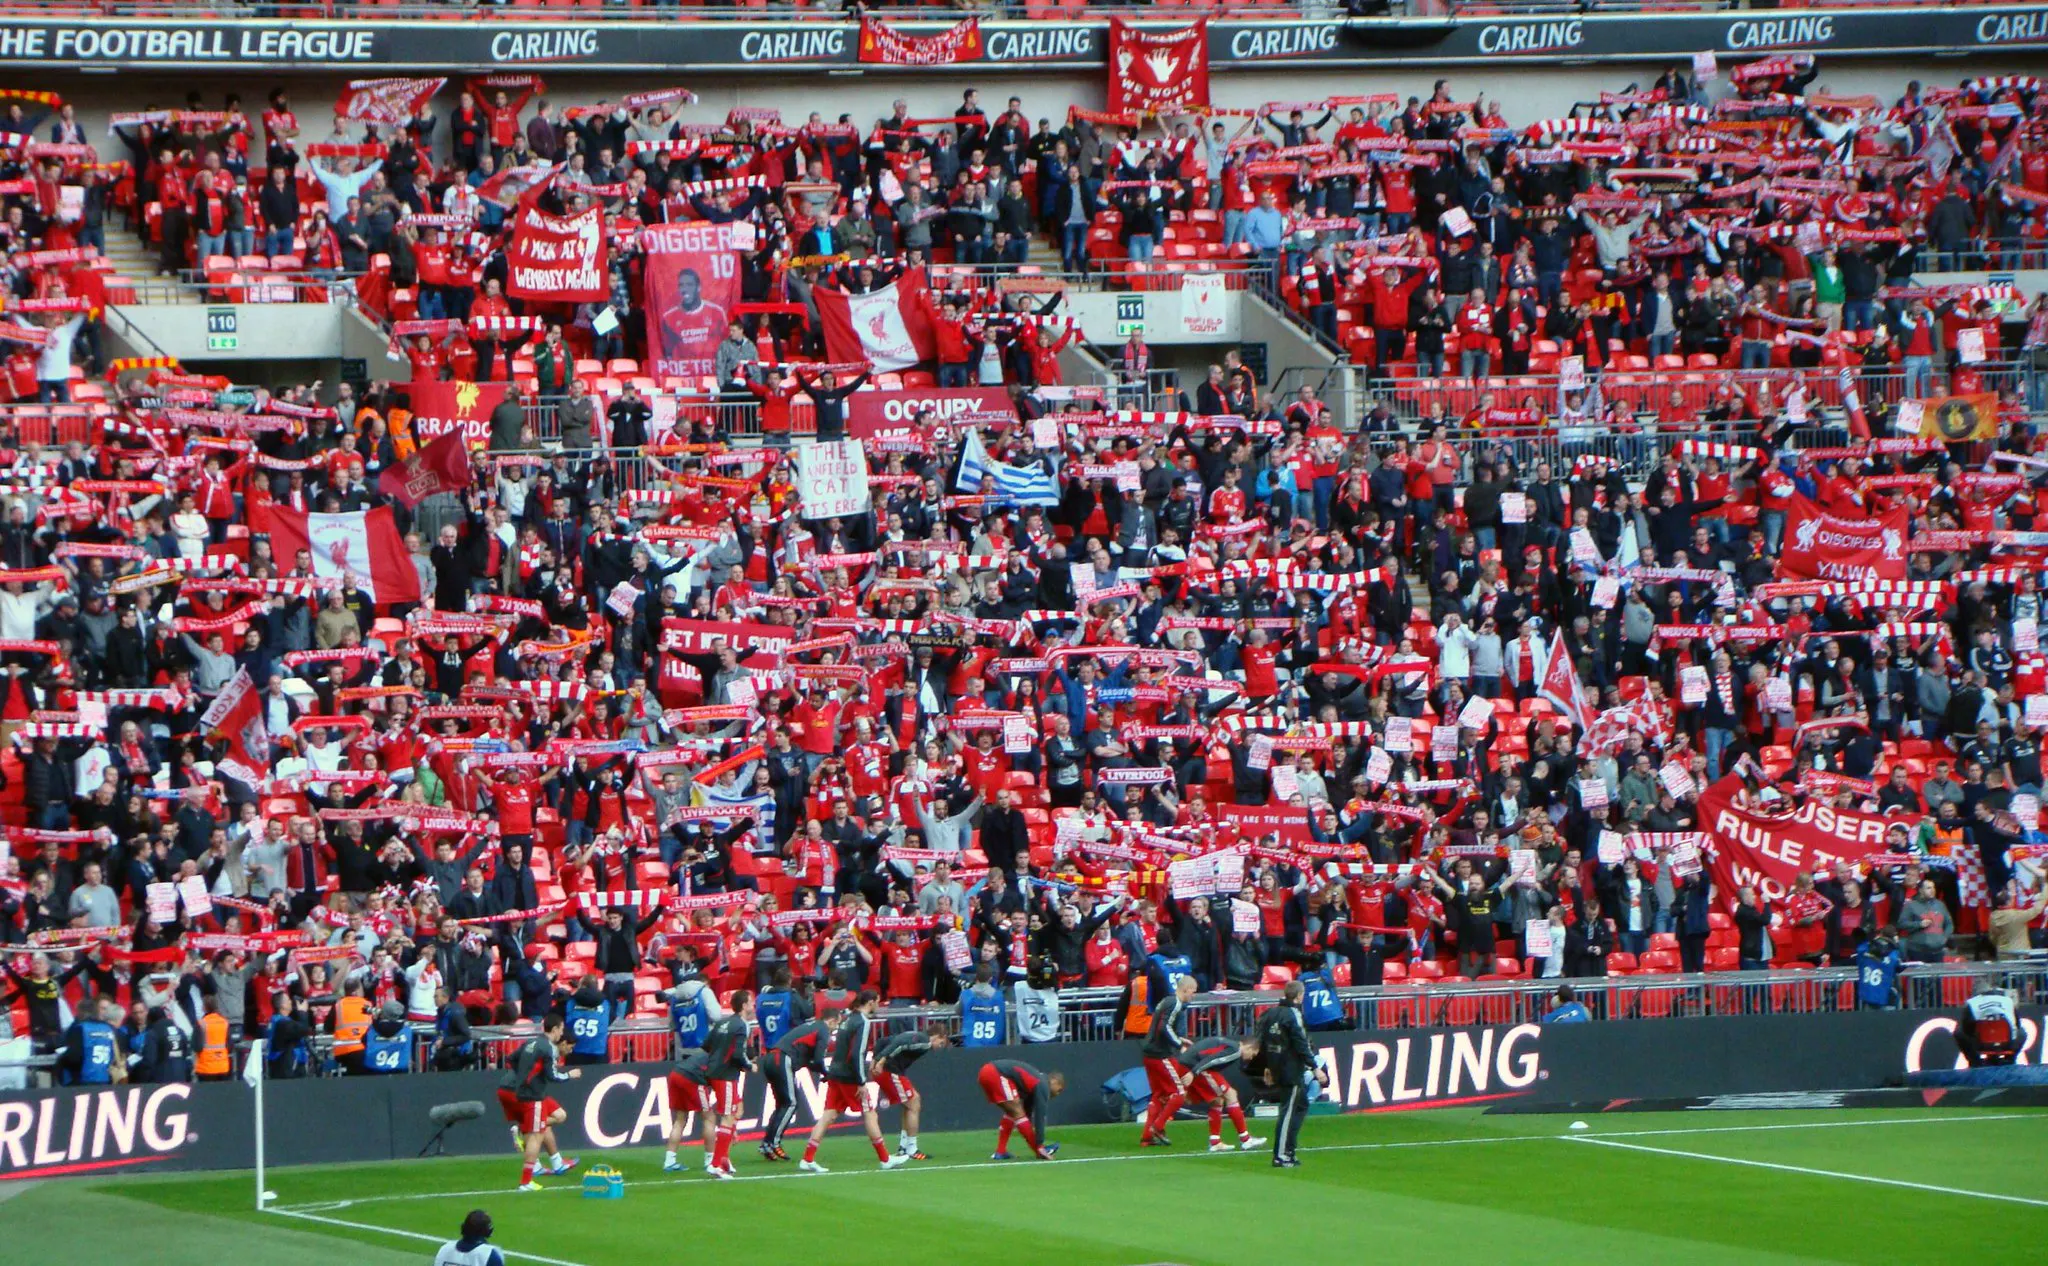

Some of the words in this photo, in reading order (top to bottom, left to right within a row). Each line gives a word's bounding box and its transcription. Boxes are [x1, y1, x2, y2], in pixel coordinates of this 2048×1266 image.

[1231, 26, 1335, 57] CARLING
[1479, 22, 1582, 53] CARLING
[1727, 17, 1834, 49] CARLING
[0, 29, 46, 56] HE
[55, 29, 230, 57] FOOTBALL
[240, 31, 373, 58] LEAGUE
[491, 30, 597, 61] CARLING
[740, 30, 844, 61] CARLING
[987, 29, 1091, 60] CARLING
[883, 50, 956, 64] SILENCED
[645, 228, 732, 255] DIGGER
[710, 254, 735, 279] 10
[515, 266, 564, 290] WEMBLEY
[565, 268, 600, 290] AGAIN
[1119, 303, 1143, 317] 111
[209, 315, 235, 330] 110
[657, 359, 715, 376] POETR
[884, 398, 982, 421] OCCUPY
[809, 442, 851, 461] THE
[812, 478, 849, 496] CAT
[811, 501, 828, 517] IS
[835, 499, 857, 514] ERE
[1818, 531, 1882, 549] DISCIPLES
[1107, 770, 1167, 781] LIVERPOOL
[682, 806, 737, 818] LIVERPOOL
[738, 806, 750, 817] FC
[1226, 814, 1239, 824] WE
[1242, 815, 1260, 824] ARE
[1264, 815, 1280, 825] THE
[425, 818, 468, 831] LIVERPOOL
[1716, 809, 1804, 866] RULE
[674, 895, 731, 910] LIVERPOOL
[772, 909, 817, 922] LIVERPOOL
[874, 916, 918, 928] LIVERPOOL
[922, 916, 934, 927] FC
[1309, 989, 1333, 1008] 72
[574, 1018, 598, 1038] 65
[679, 1013, 697, 1033] 20
[973, 1021, 996, 1039] 85
[1029, 1013, 1049, 1030] 24
[376, 1050, 400, 1069] 94
[1312, 1022, 1541, 1104] ARLING
[0, 1082, 191, 1168] RLING
